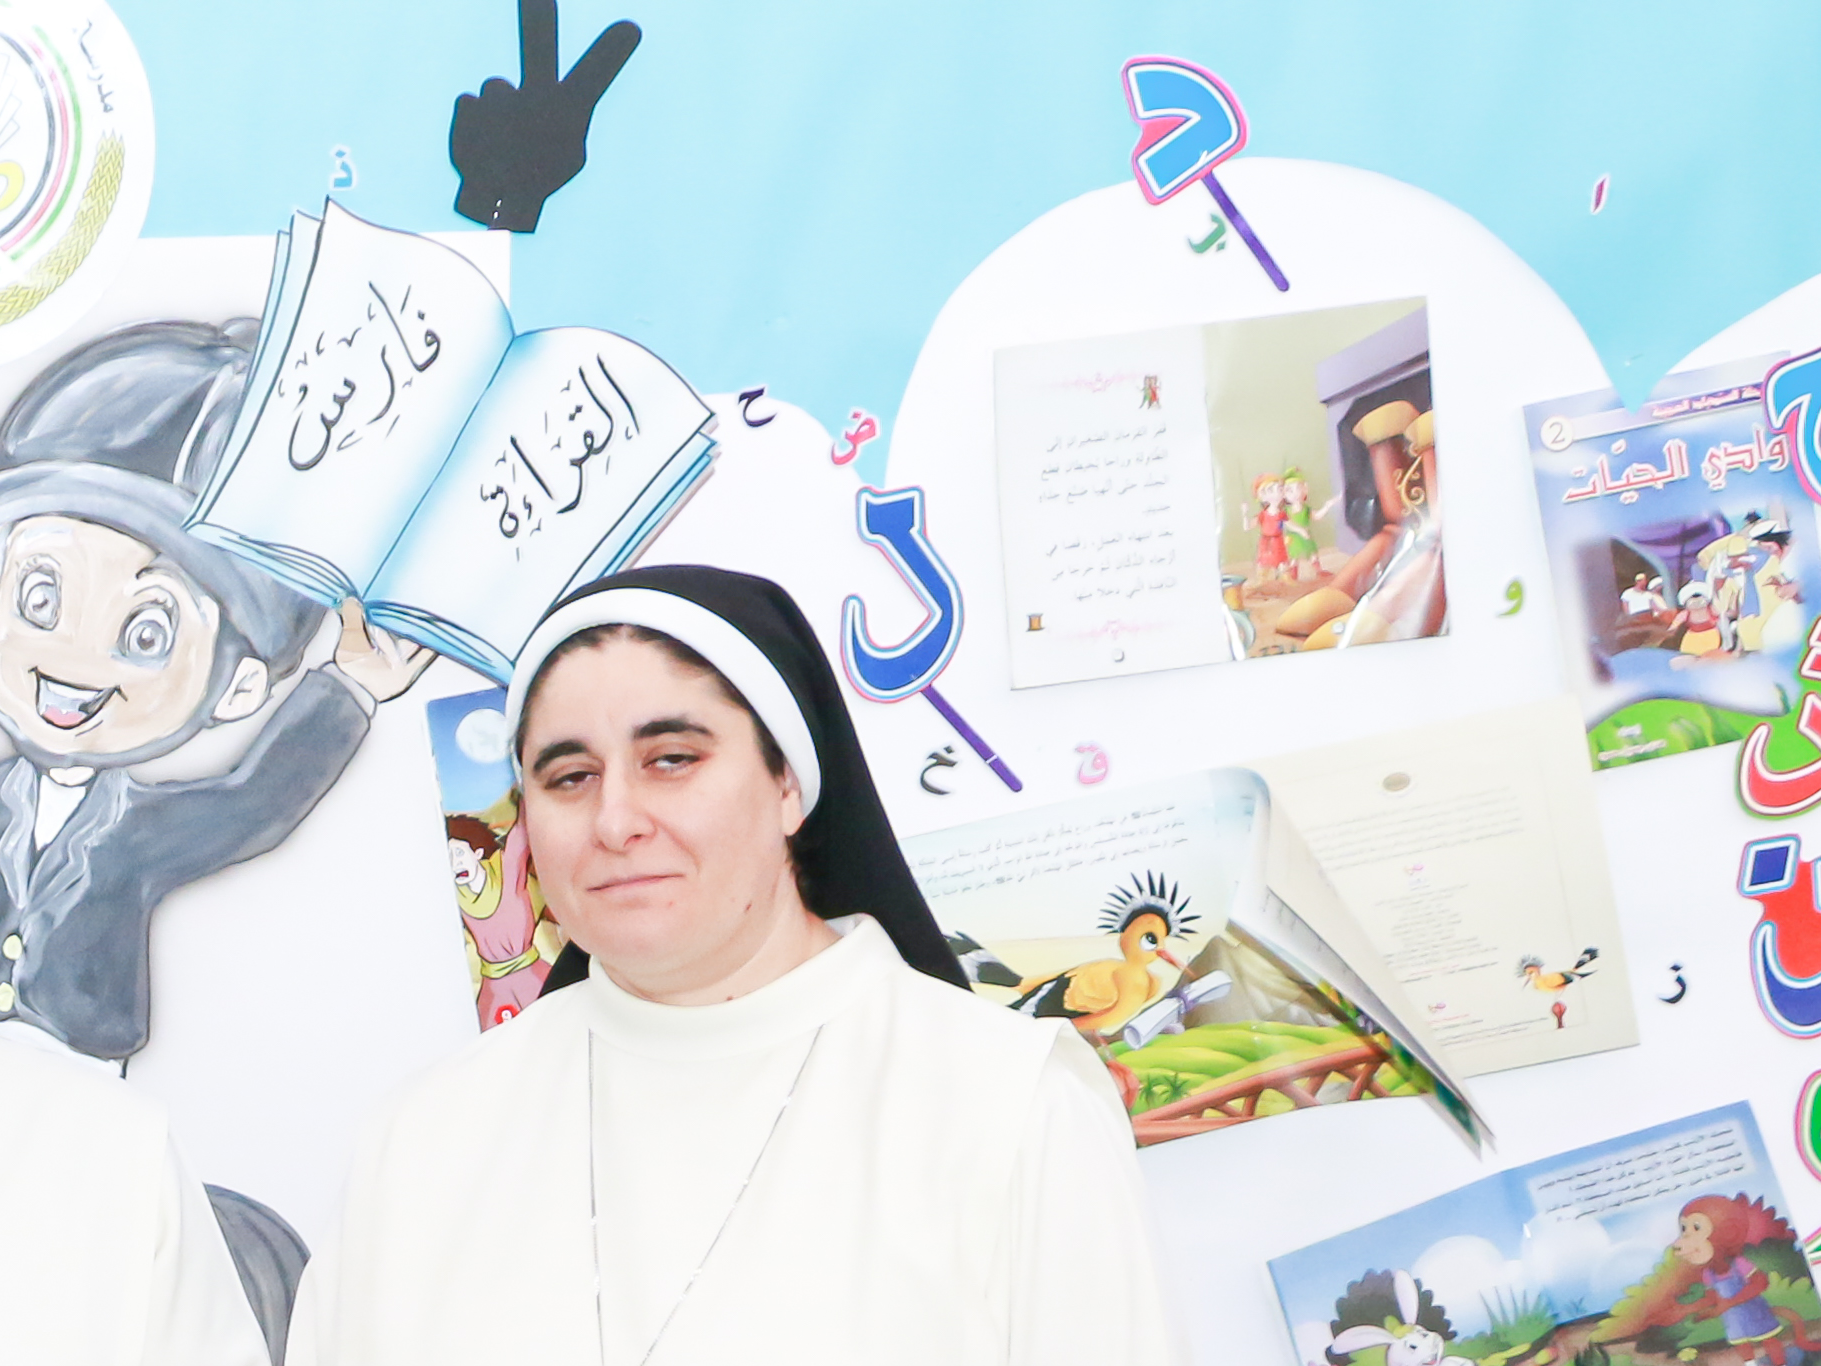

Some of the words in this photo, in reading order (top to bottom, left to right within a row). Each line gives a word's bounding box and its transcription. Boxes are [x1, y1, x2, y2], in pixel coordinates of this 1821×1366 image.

[332, 147, 355, 189] ذ
[1186, 213, 1227, 254] ب
[737, 385, 777, 427] ح
[831, 408, 877, 464] ض
[1549, 421, 1565, 444] 2
[1497, 579, 1525, 618] و
[920, 745, 958, 795] خ
[1075, 744, 1108, 785] ق
[1658, 963, 1688, 1005] ز
